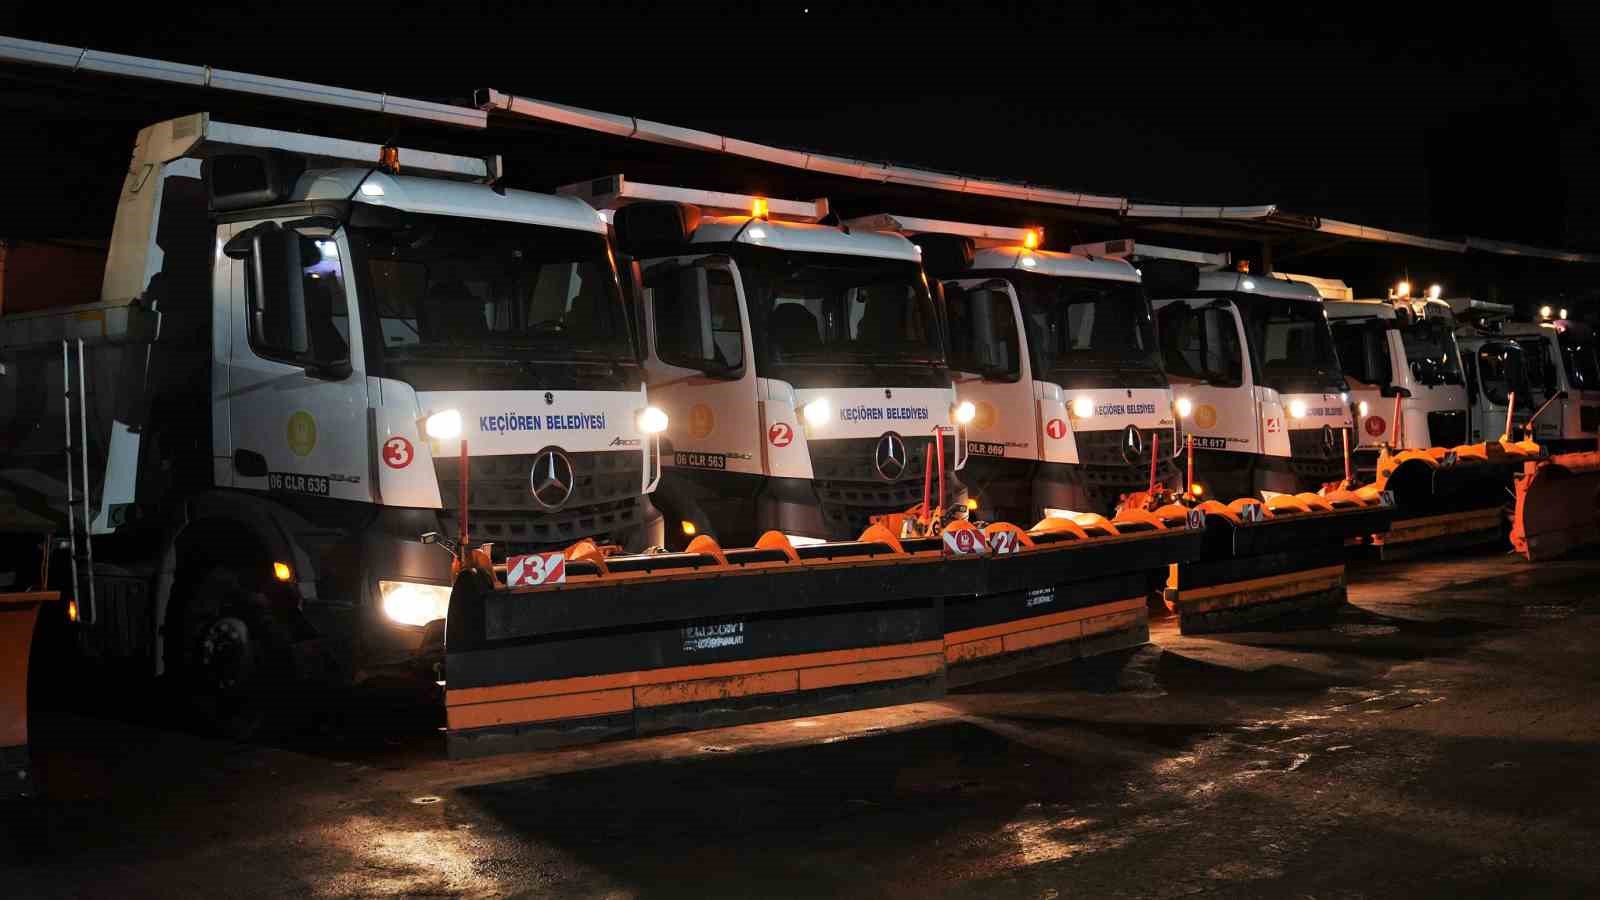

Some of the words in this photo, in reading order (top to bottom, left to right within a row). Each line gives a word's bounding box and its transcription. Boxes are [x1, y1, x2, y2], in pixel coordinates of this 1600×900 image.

[480, 412, 542, 435] KEÇİÖREN
[546, 411, 606, 430] BELEDİYESİ
[840, 405, 883, 423] KEÇİÖREN
[886, 405, 929, 420] BELEDİYESİ
[772, 424, 789, 444] 2
[1049, 420, 1061, 438] 1
[387, 439, 409, 465] 3
[689, 455, 706, 467] CLR
[270, 474, 282, 489] 06
[284, 475, 305, 492] CLR
[308, 477, 328, 494] 636
[998, 531, 1010, 554] 2
[524, 555, 546, 585] 3
